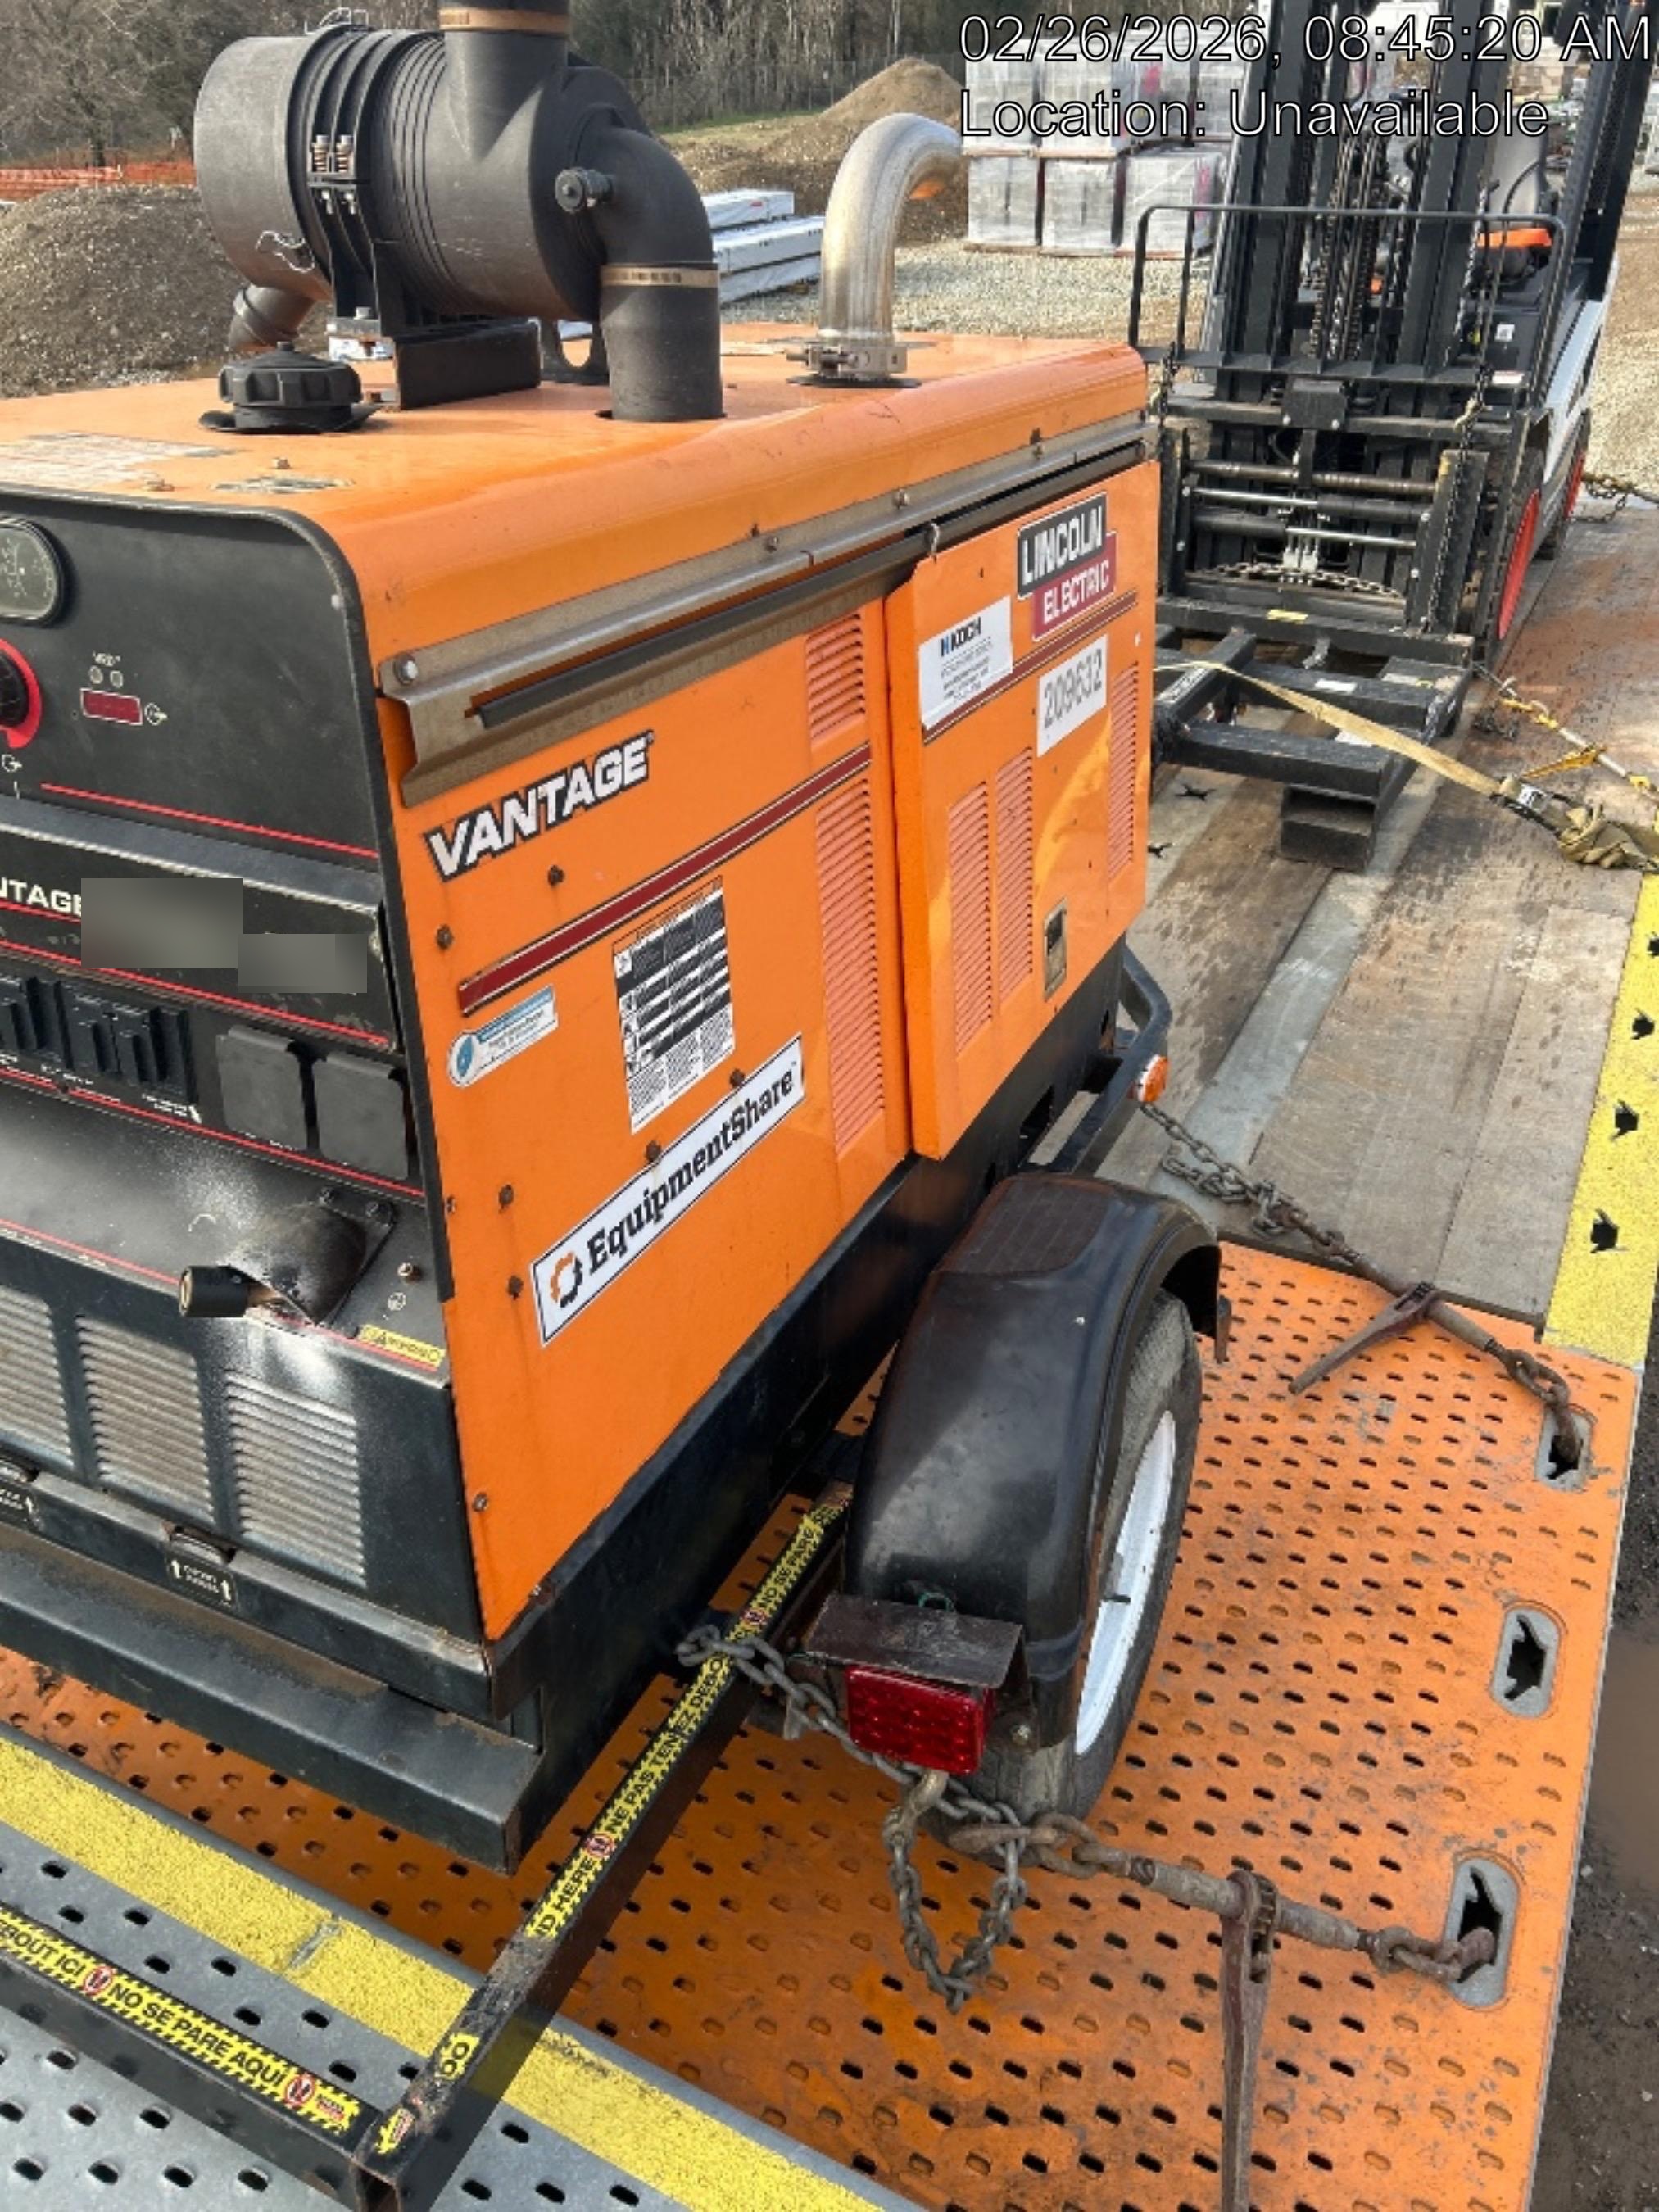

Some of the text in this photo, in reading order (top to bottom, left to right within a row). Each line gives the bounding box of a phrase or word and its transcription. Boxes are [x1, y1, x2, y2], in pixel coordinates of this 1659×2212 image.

[1022, 505, 1103, 586] LINCOLN
[1044, 560, 1109, 625] ELECTRIC
[425, 732, 652, 880] VANTAGE
[587, 1068, 794, 1276] EquipmentShare
[551, 1857, 595, 1912] HERE
[53, 1953, 87, 1977] ICI
[107, 1983, 143, 2008] NO
[142, 2001, 175, 2026] SE
[172, 2017, 234, 2058] PARE
